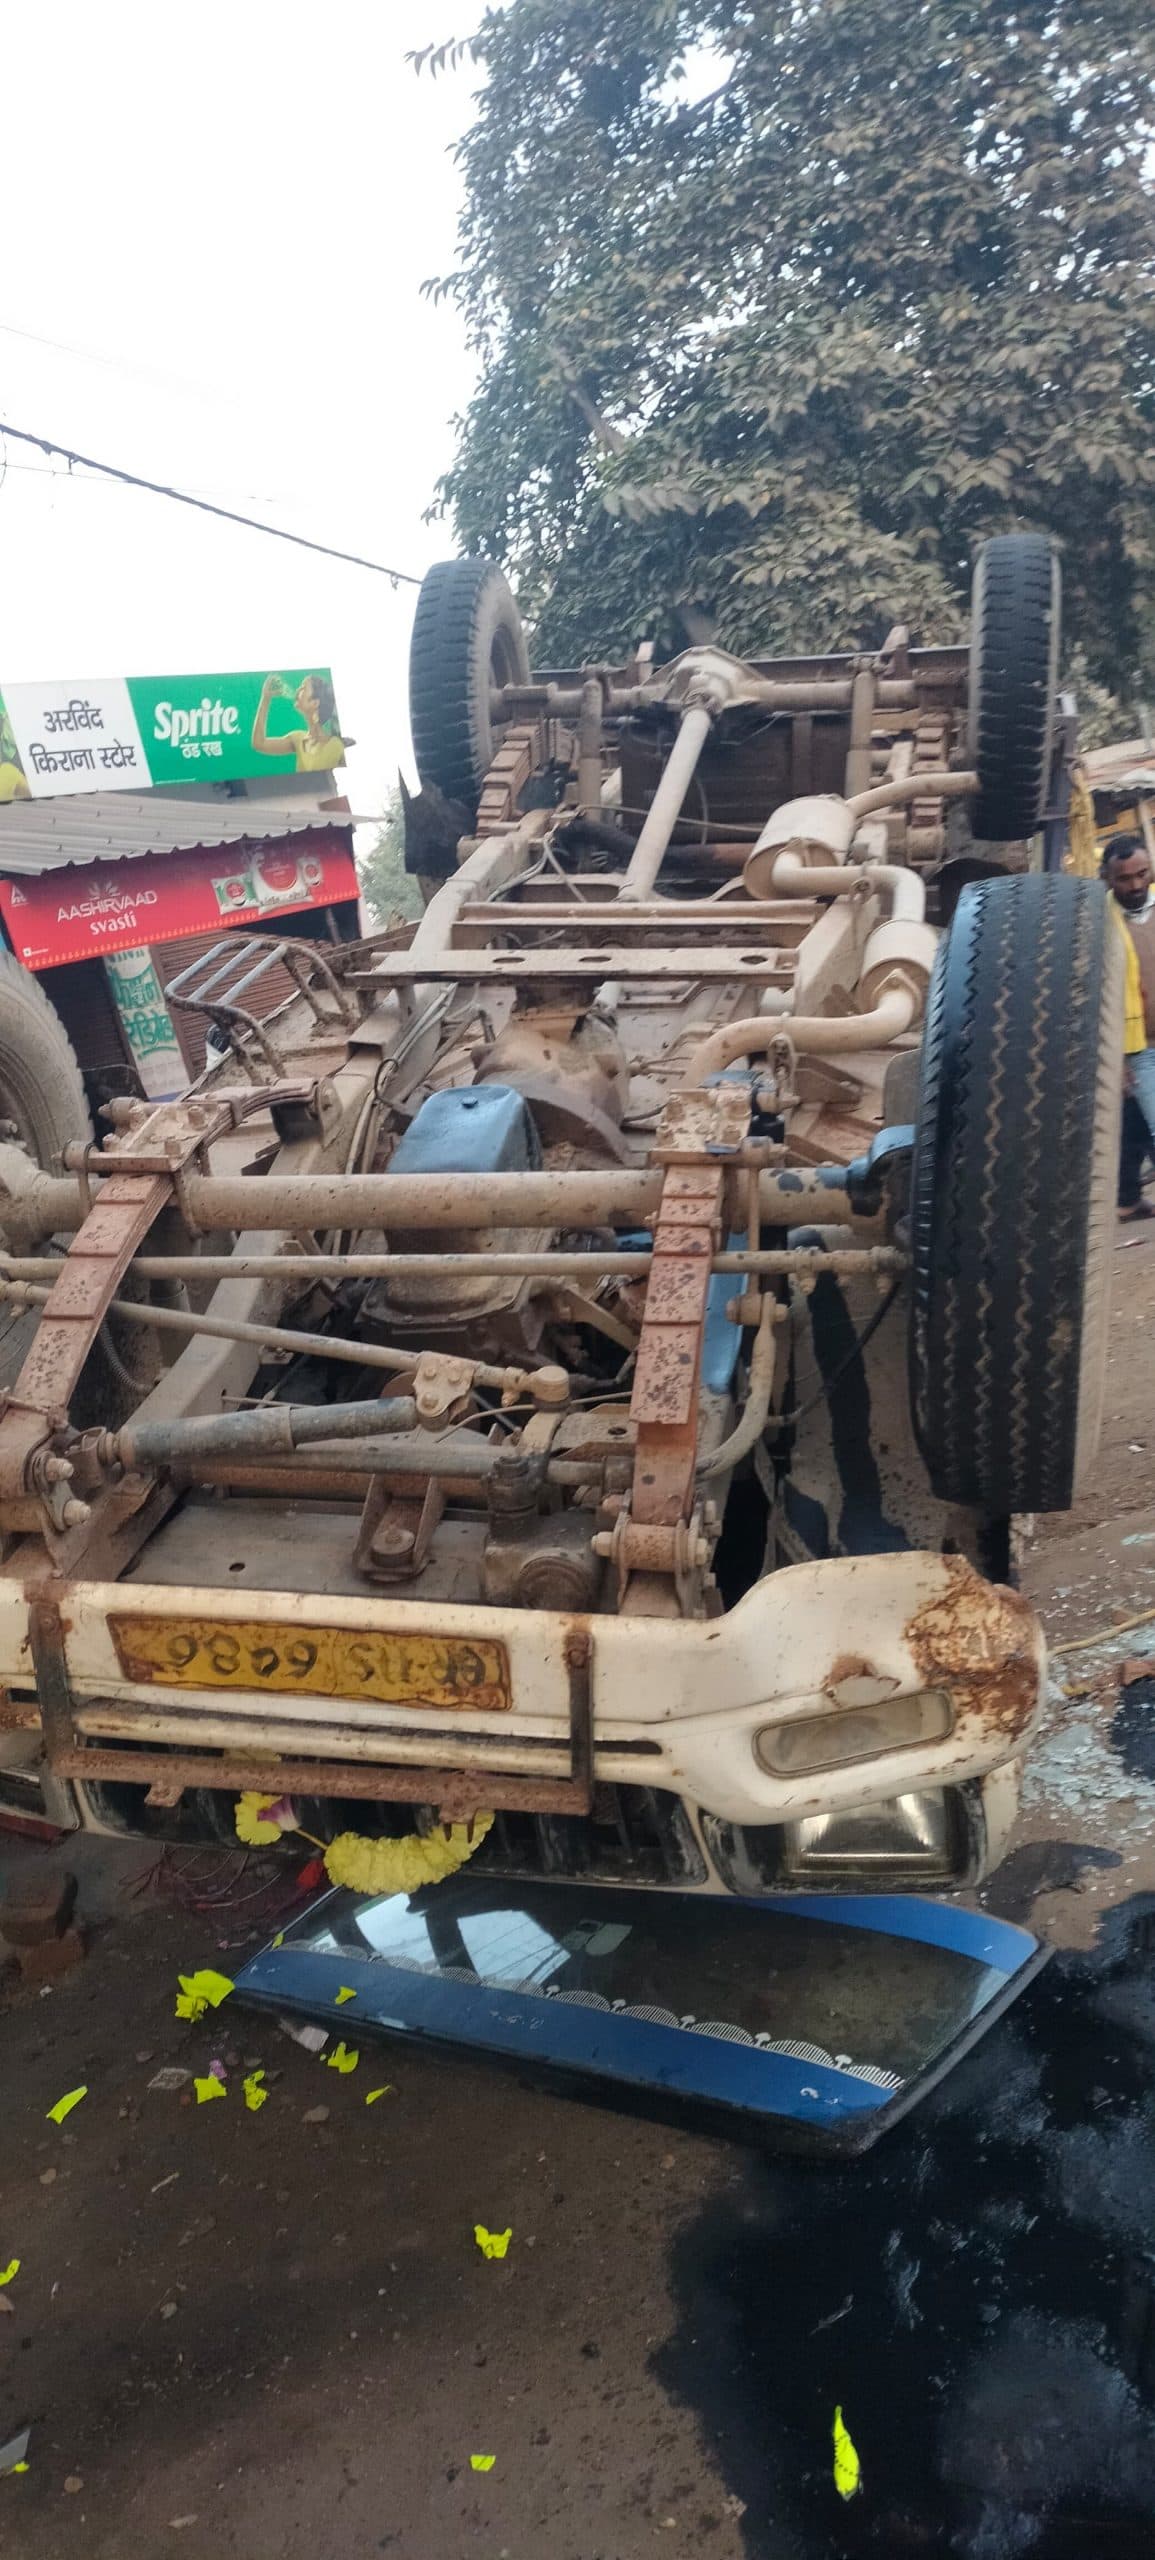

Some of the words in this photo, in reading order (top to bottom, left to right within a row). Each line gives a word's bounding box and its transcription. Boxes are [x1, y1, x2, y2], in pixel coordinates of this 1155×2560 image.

[43, 699, 104, 732] अरविंद
[154, 697, 239, 748] Sprite
[29, 743, 96, 774] किराना
[97, 738, 137, 768] स्टोर
[180, 737, 201, 759] ठंड
[201, 741, 223, 757] रख
[57, 890, 157, 922] AASHIRVAAD
[90, 910, 137, 936] svasti
